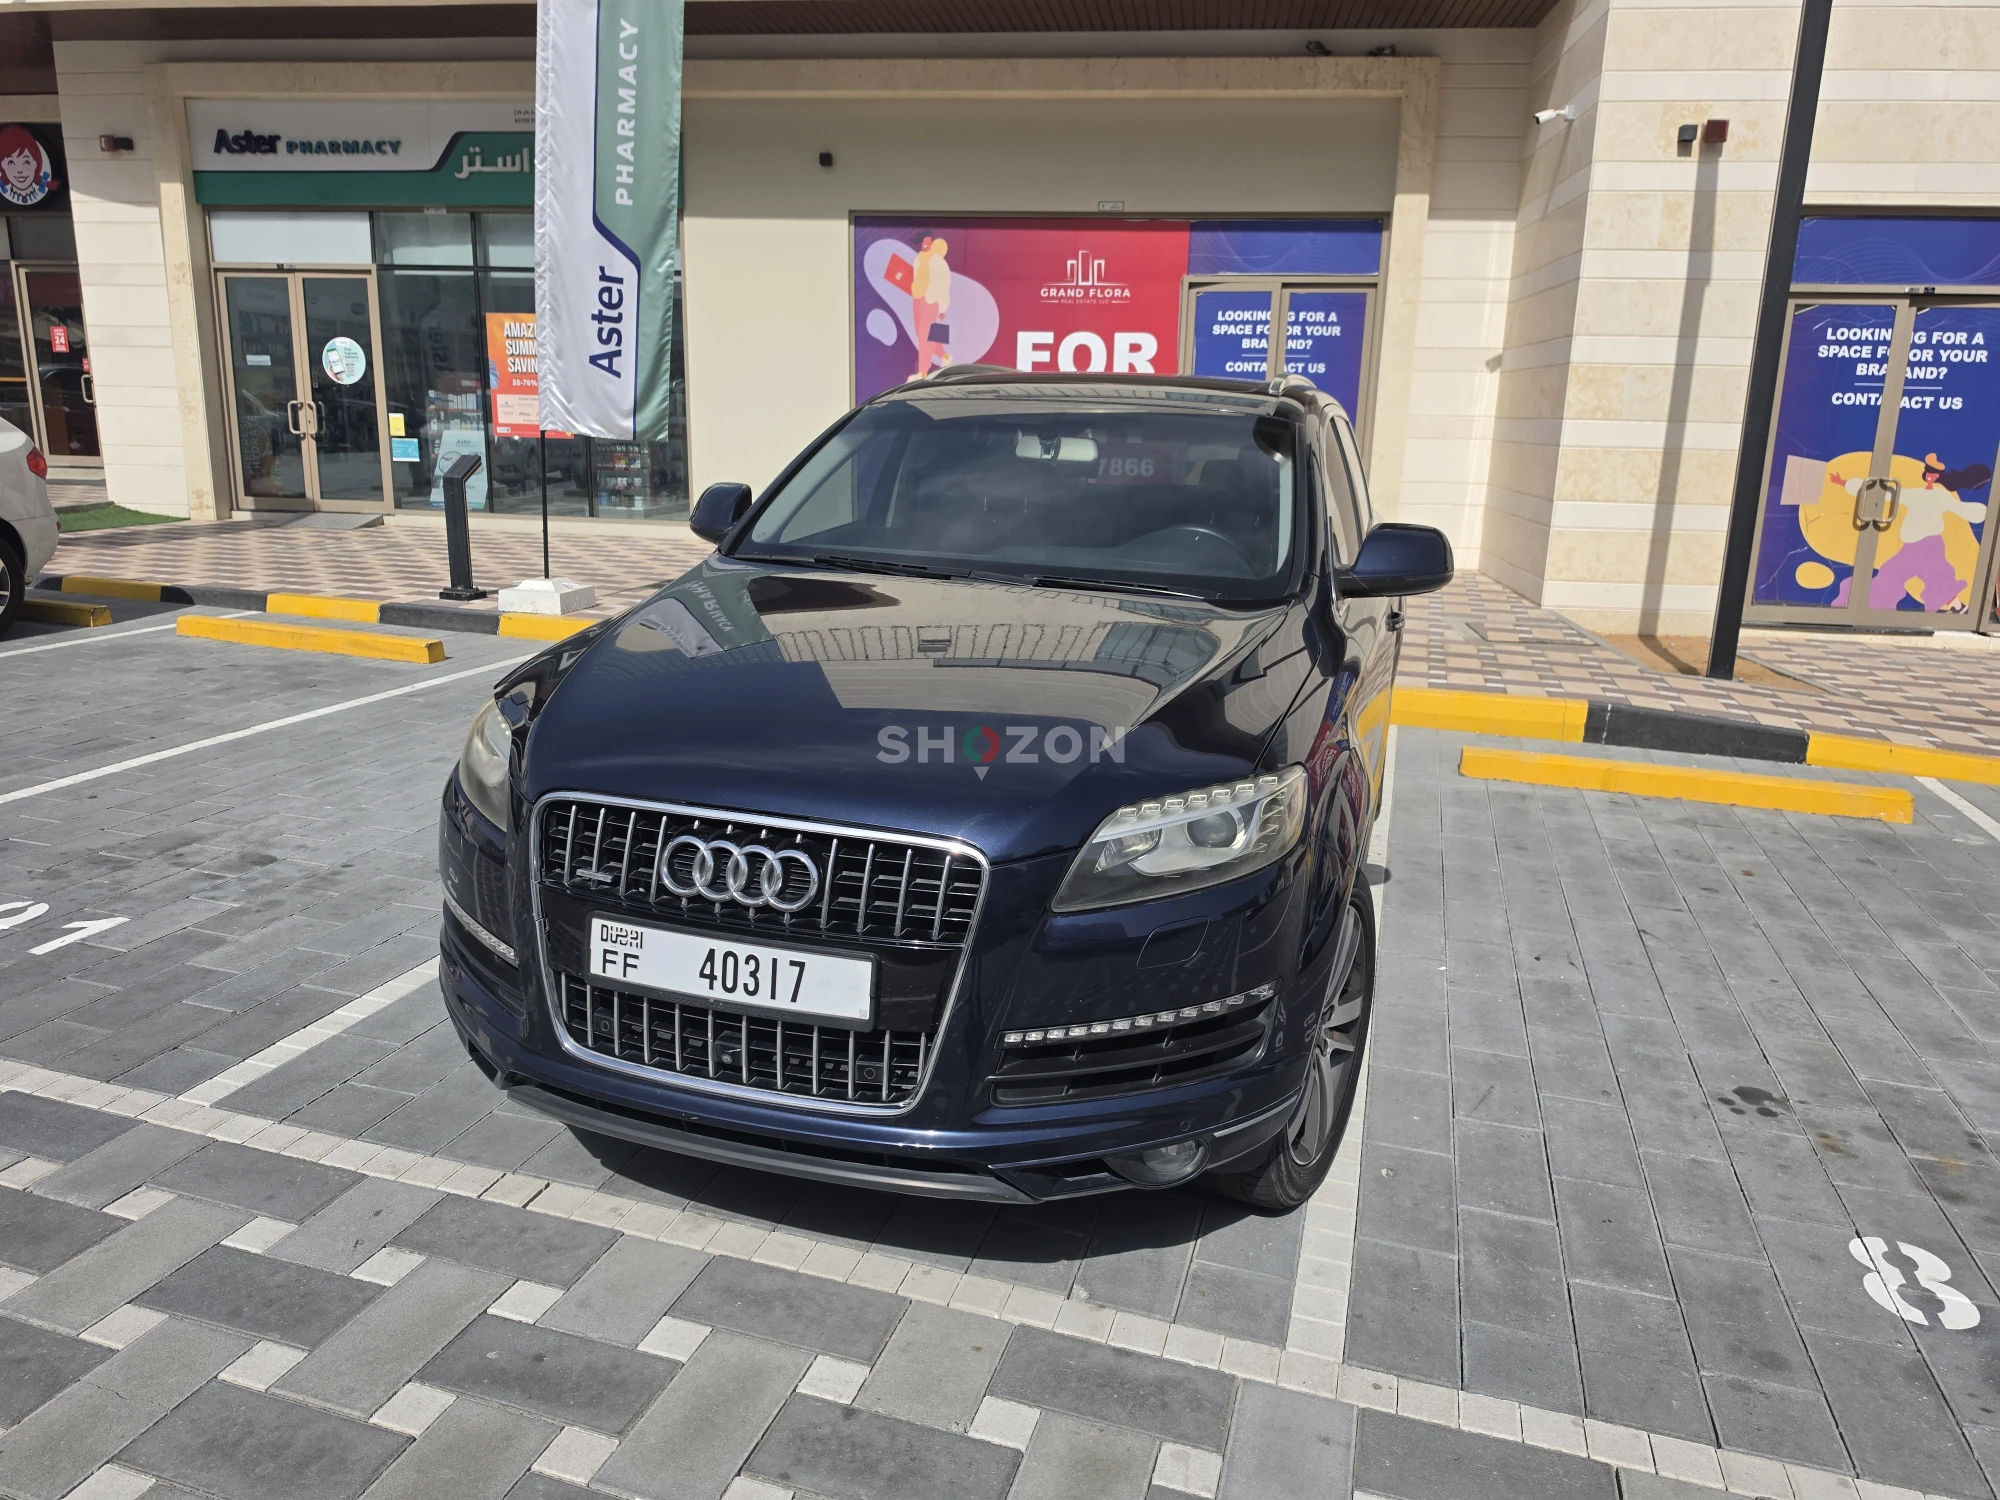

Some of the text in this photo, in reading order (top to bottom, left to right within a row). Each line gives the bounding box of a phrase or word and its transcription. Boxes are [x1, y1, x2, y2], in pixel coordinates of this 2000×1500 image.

[614, 17, 639, 207] PHARMACY
[213, 128, 402, 155] Aster PHARMACY
[1040, 287, 1131, 298] GRAND FLORA
[588, 265, 624, 379] Aster
[1299, 312, 1325, 322] FOR
[1328, 312, 1338, 322] A
[1212, 324, 1253, 335] SPACE
[1305, 325, 1341, 337] YOUR
[1931, 332, 1968, 345] FOR
[1971, 332, 1984, 345] A
[54, 335, 66, 345] 24
[1016, 331, 1158, 373] FOR
[1817, 345, 1873, 358] SPACE
[1938, 349, 1988, 363] YOUR
[1307, 362, 1326, 374] US
[1938, 396, 1963, 410] US
[602, 948, 806, 1003] FF 40317
[1848, 1236, 1981, 1330] 8
